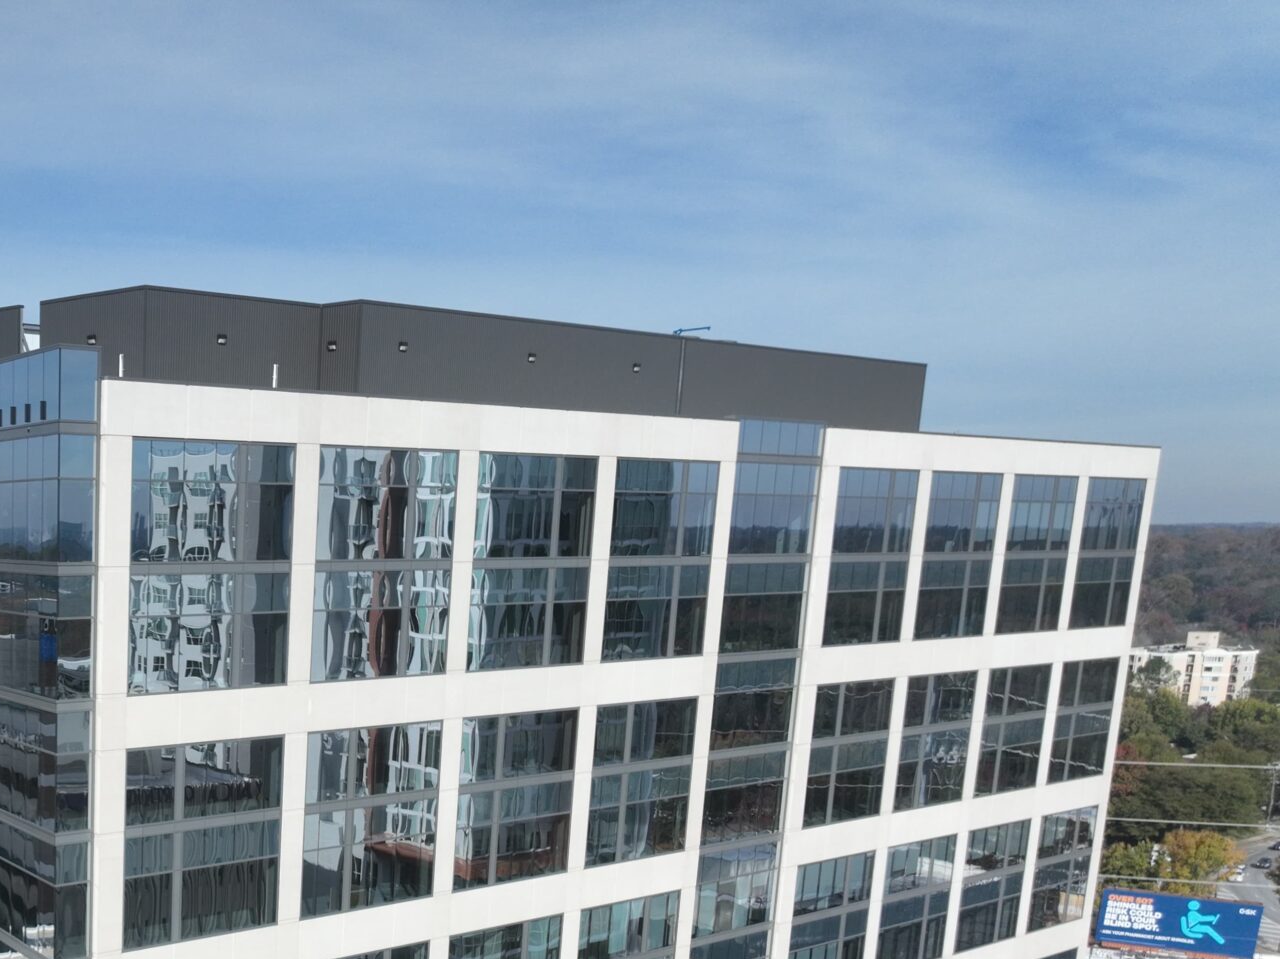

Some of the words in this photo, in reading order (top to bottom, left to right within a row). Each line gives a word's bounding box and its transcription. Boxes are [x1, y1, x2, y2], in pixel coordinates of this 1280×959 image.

[1108, 894, 1135, 903] OVER
[1107, 900, 1154, 911] SHINGLES
[1106, 907, 1128, 915] RISK
[1129, 909, 1163, 919] COULD
[1118, 914, 1129, 922] IN
[1130, 916, 1156, 925] YOUR
[1103, 919, 1132, 928] BLIND
[1132, 922, 1160, 932] SPOT.
